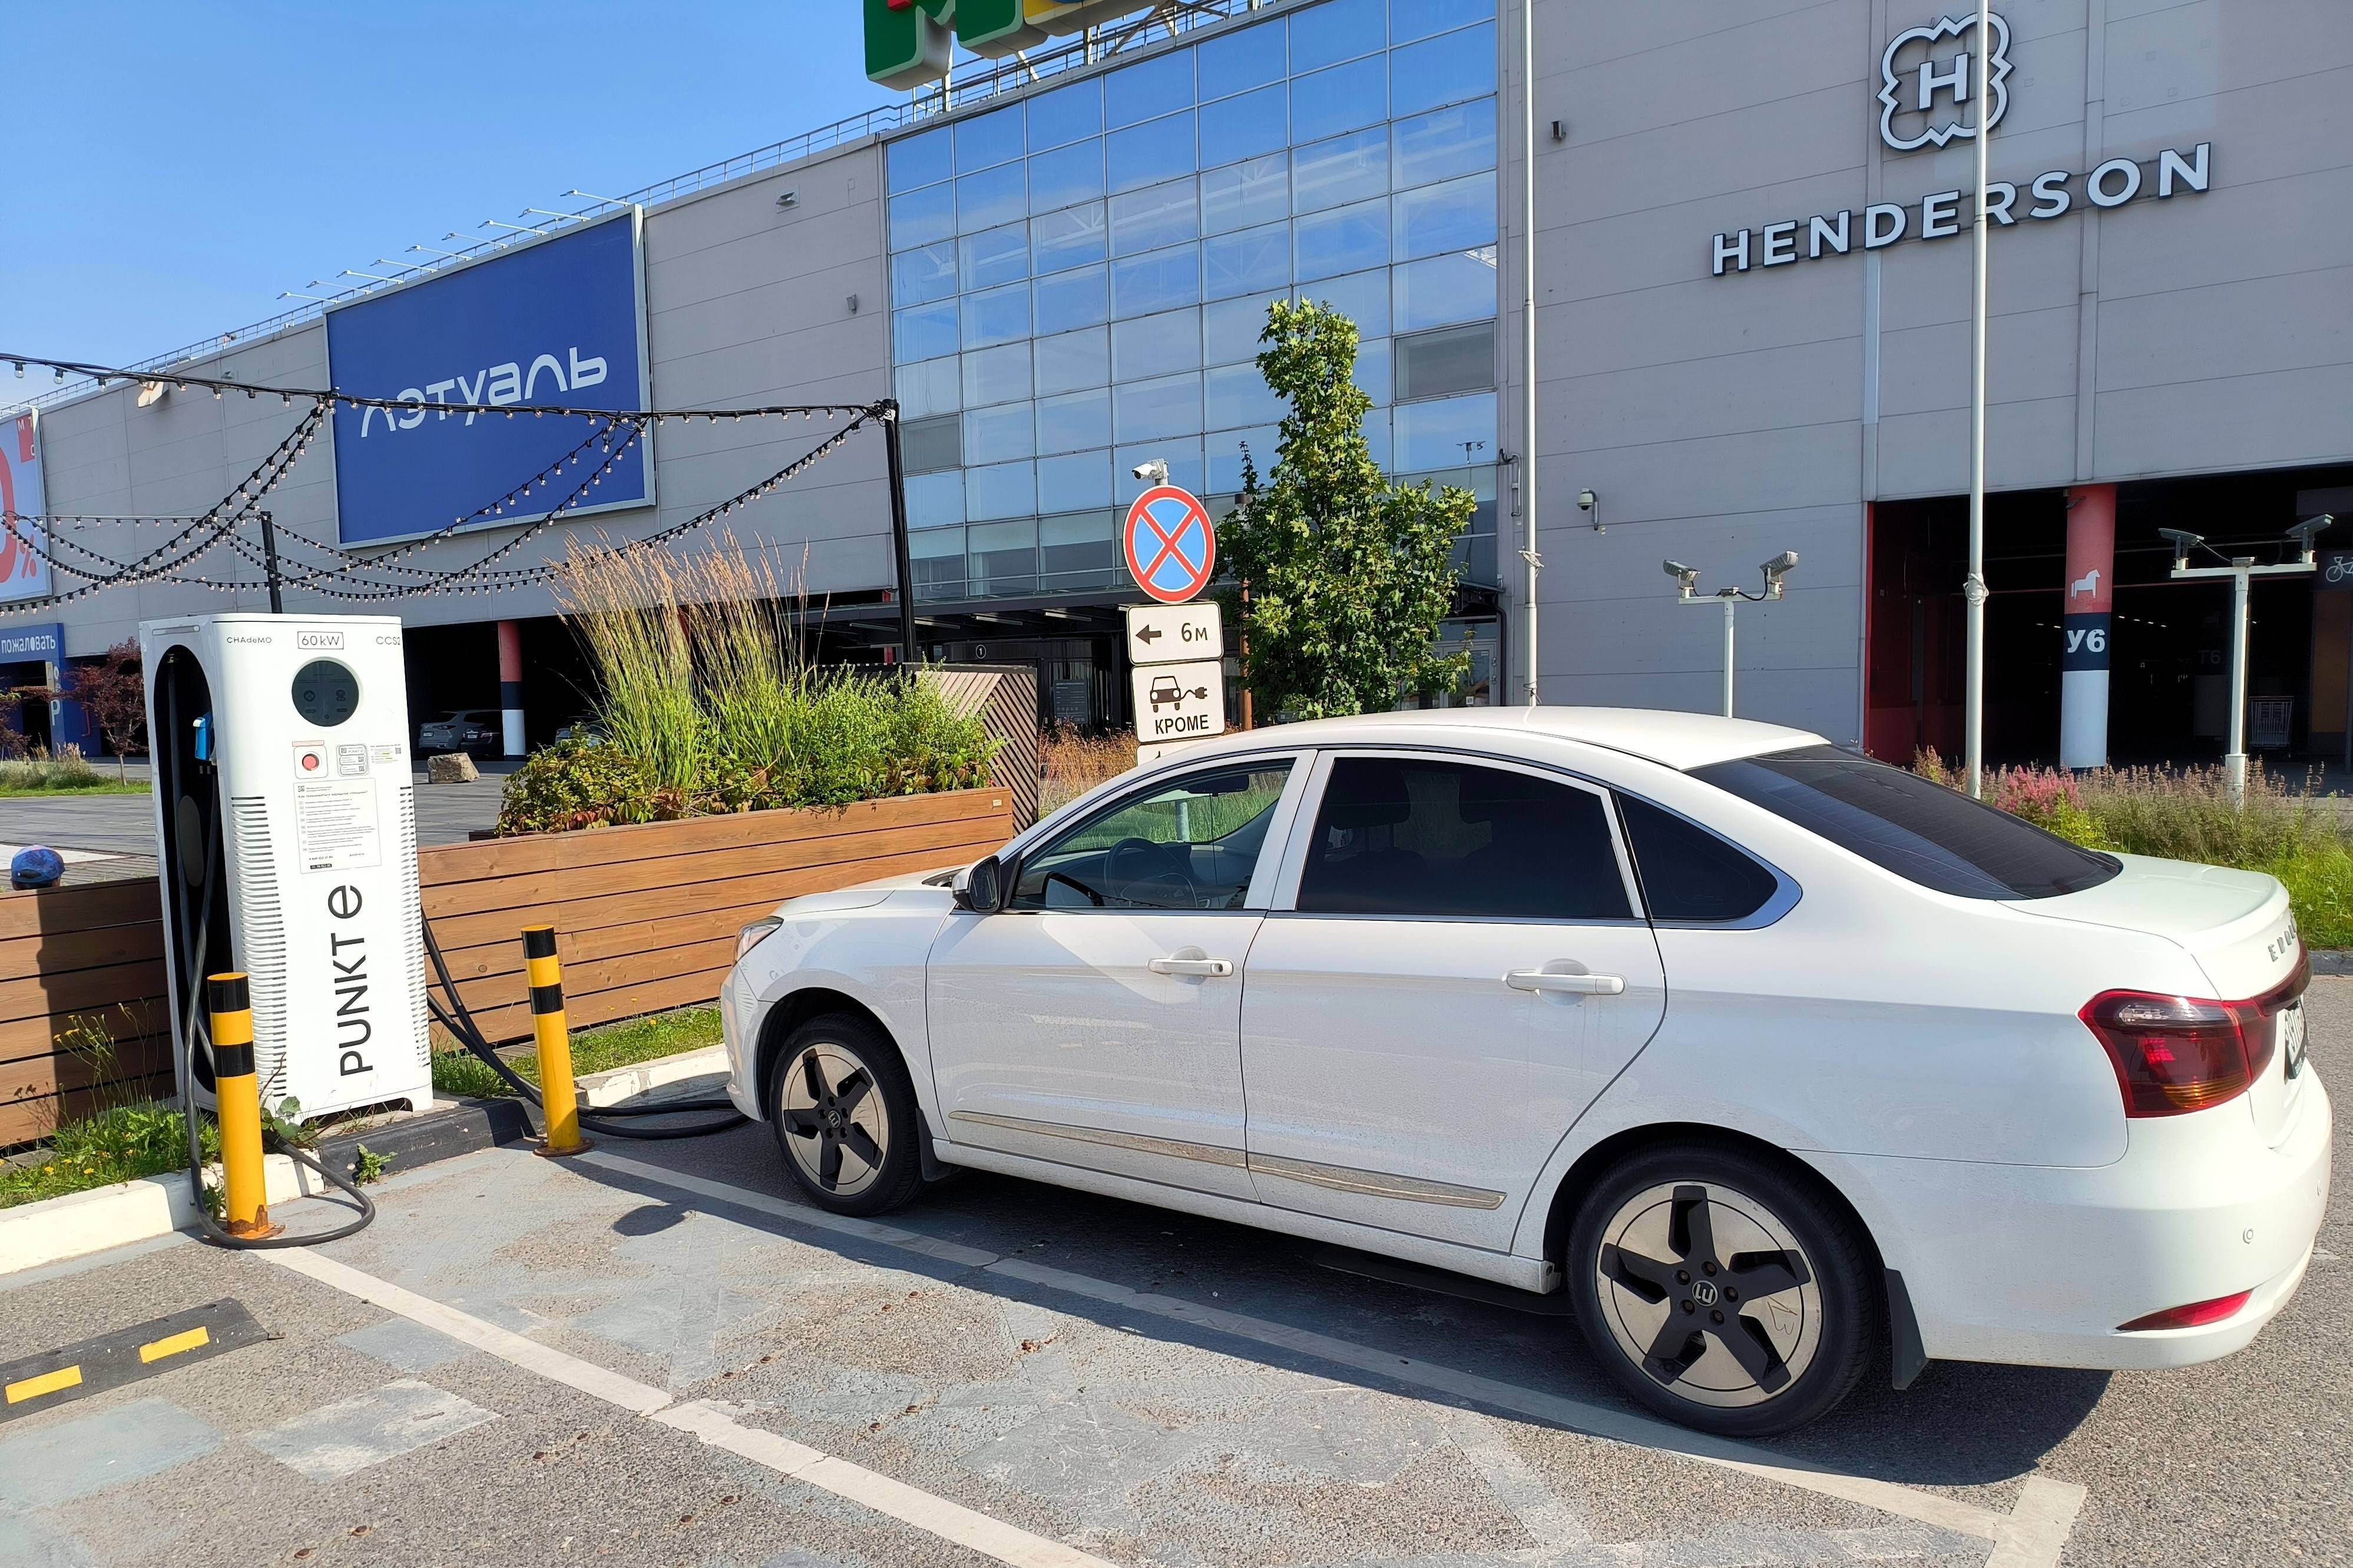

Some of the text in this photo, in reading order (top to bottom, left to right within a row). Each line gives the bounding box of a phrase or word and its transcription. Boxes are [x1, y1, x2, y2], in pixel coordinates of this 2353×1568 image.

[1918, 52, 1971, 112] H
[1712, 141, 2212, 277] HENDERSON
[1, 635, 56, 654] пожаловать
[226, 636, 272, 644] CHAdeMO
[375, 636, 401, 645] CCS2
[1155, 714, 1209, 735] КРОМЕ
[330, 932, 373, 1076] PUNKT
